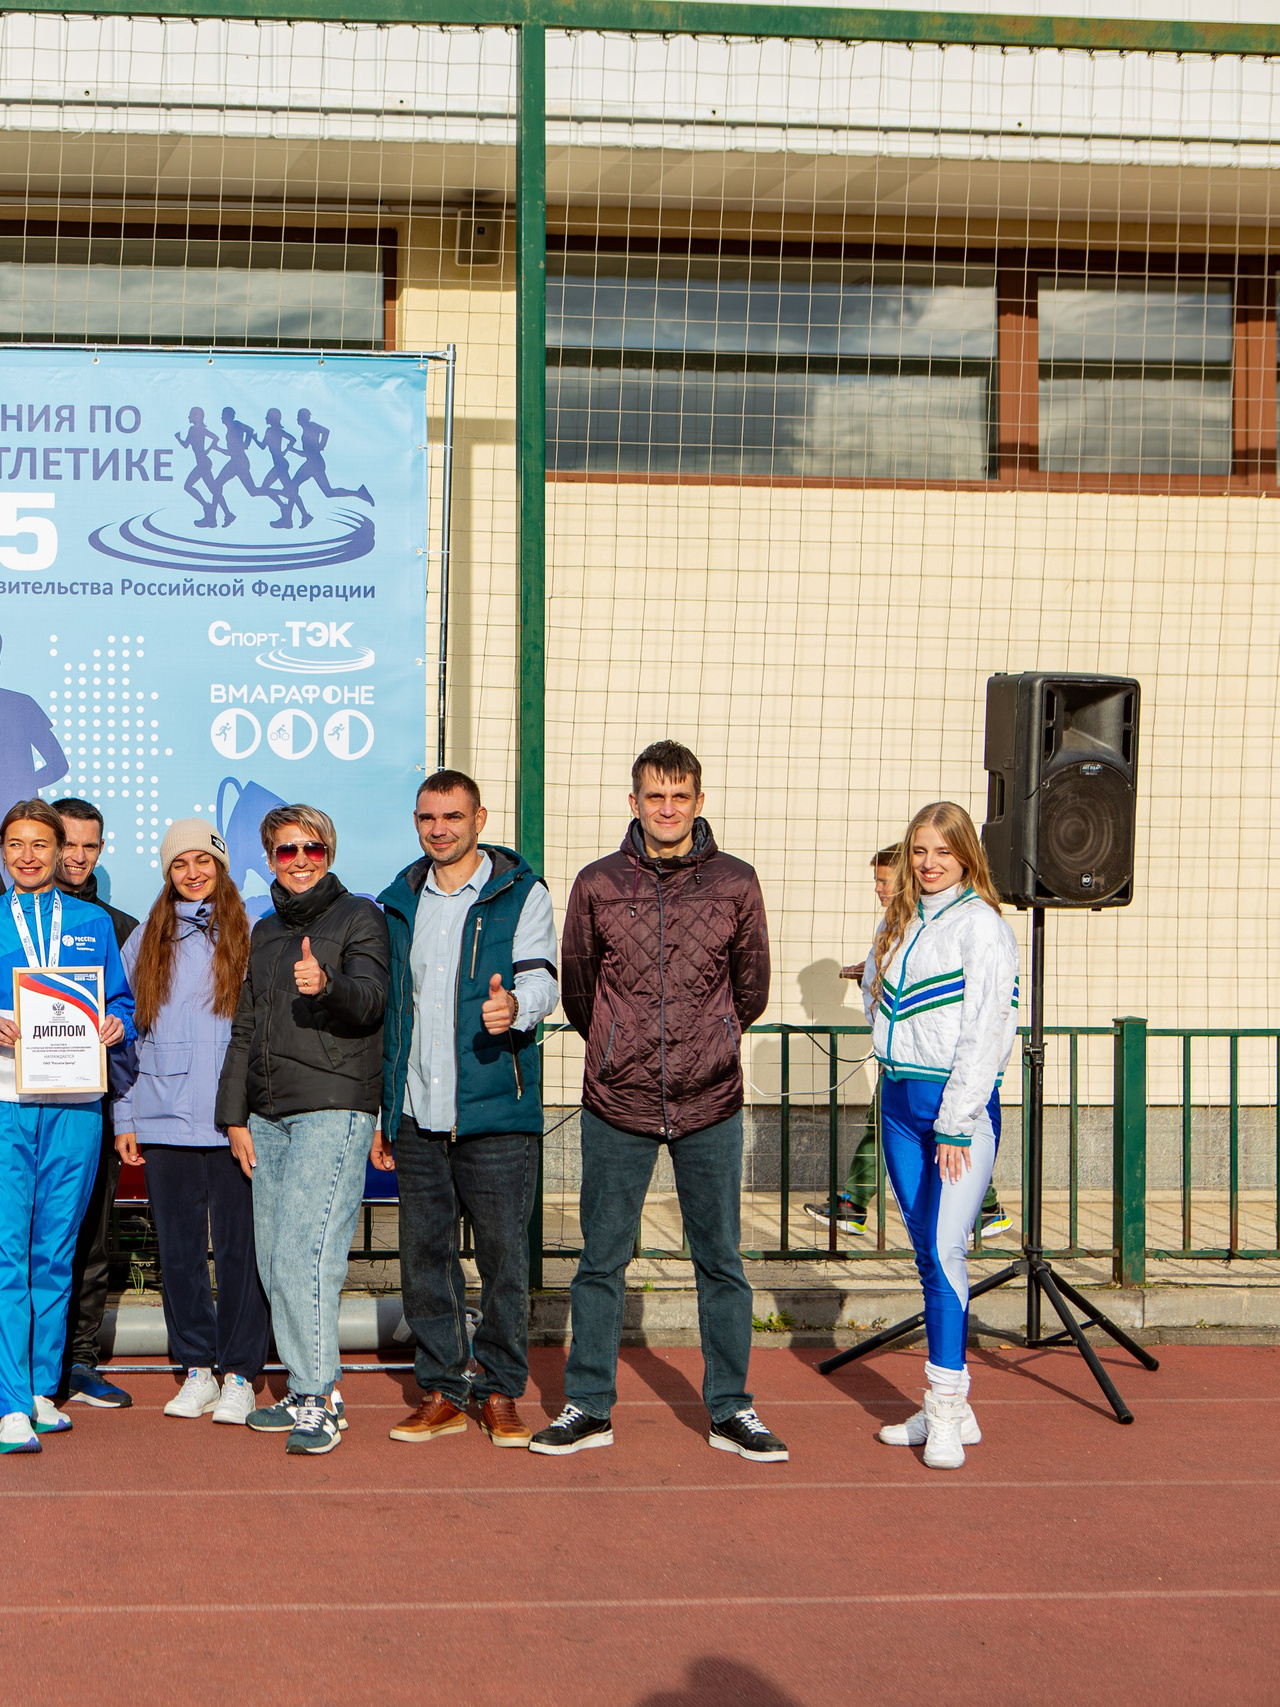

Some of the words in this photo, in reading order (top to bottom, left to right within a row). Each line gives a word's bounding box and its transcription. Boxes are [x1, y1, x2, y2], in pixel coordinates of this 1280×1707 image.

[89, 404, 142, 434] ПО
[121, 578, 245, 599] Российской
[251, 579, 376, 602] Федерации
[33, 1025, 86, 1039] ДИПЛОМ
